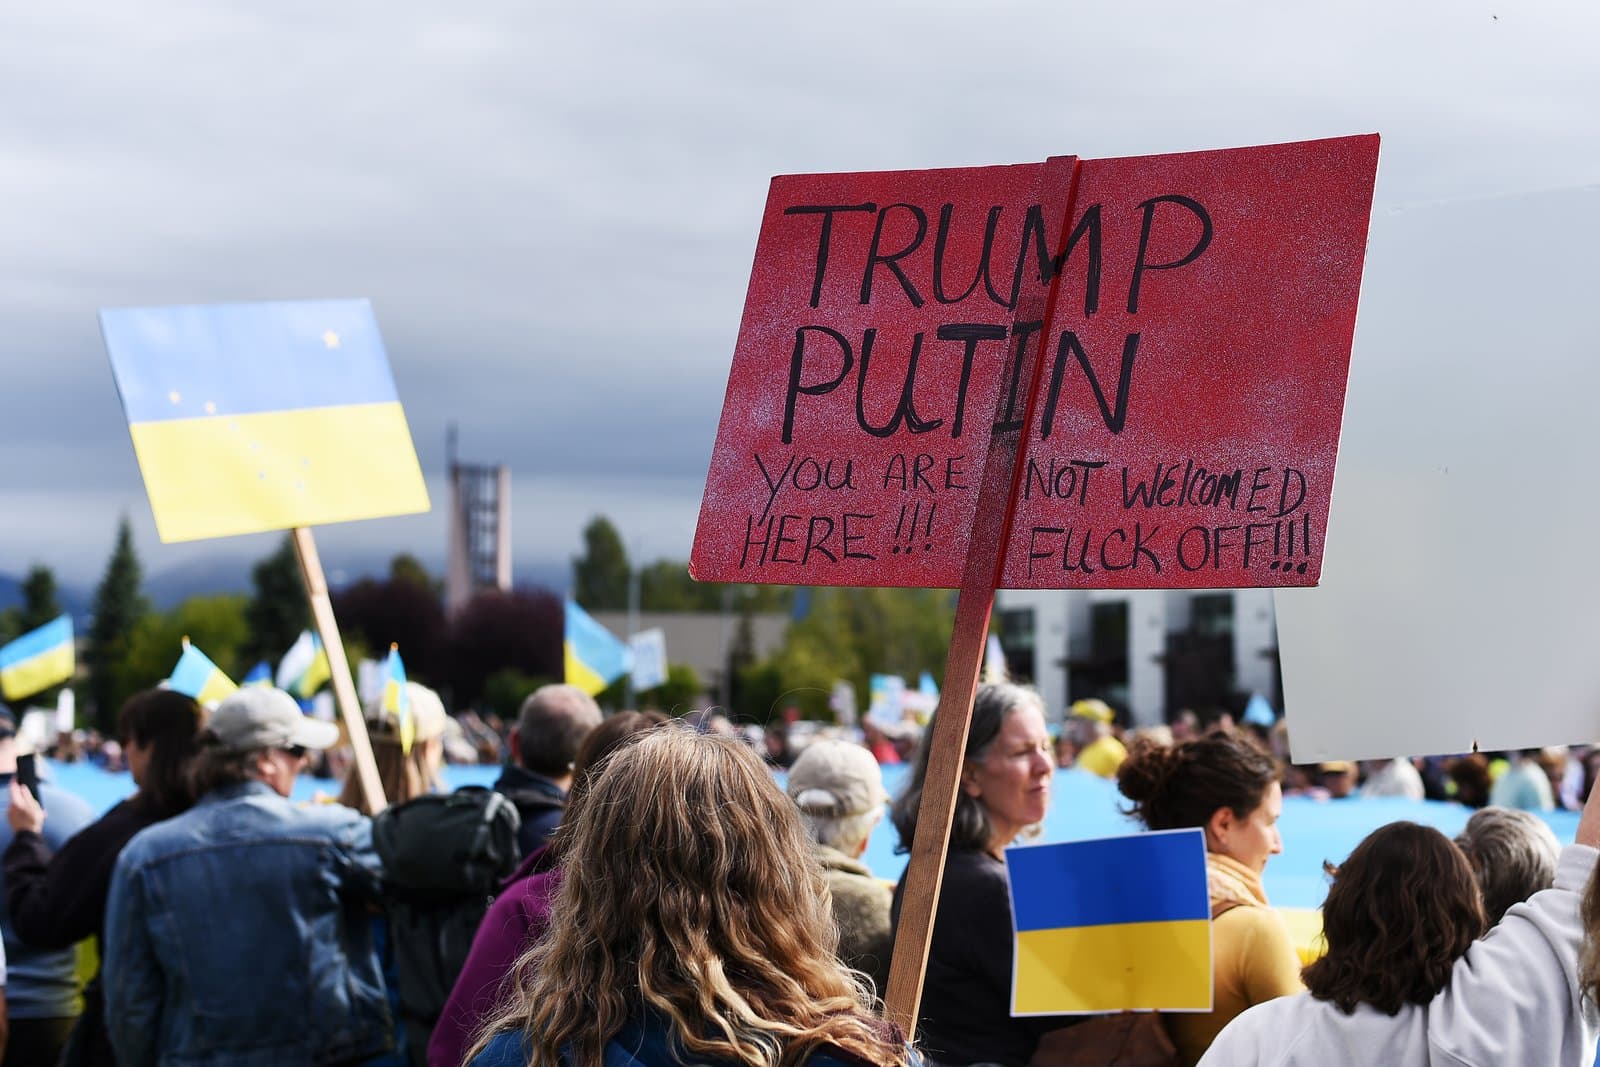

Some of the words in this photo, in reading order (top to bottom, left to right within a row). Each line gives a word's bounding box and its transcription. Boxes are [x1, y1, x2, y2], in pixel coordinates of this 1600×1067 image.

[784, 193, 1213, 316] TRUMP
[781, 320, 1140, 445] PUTIN
[881, 453, 968, 493] ARE
[1024, 457, 1110, 505] NOT
[738, 513, 876, 569] HERE
[1028, 522, 1161, 580] FUCK
